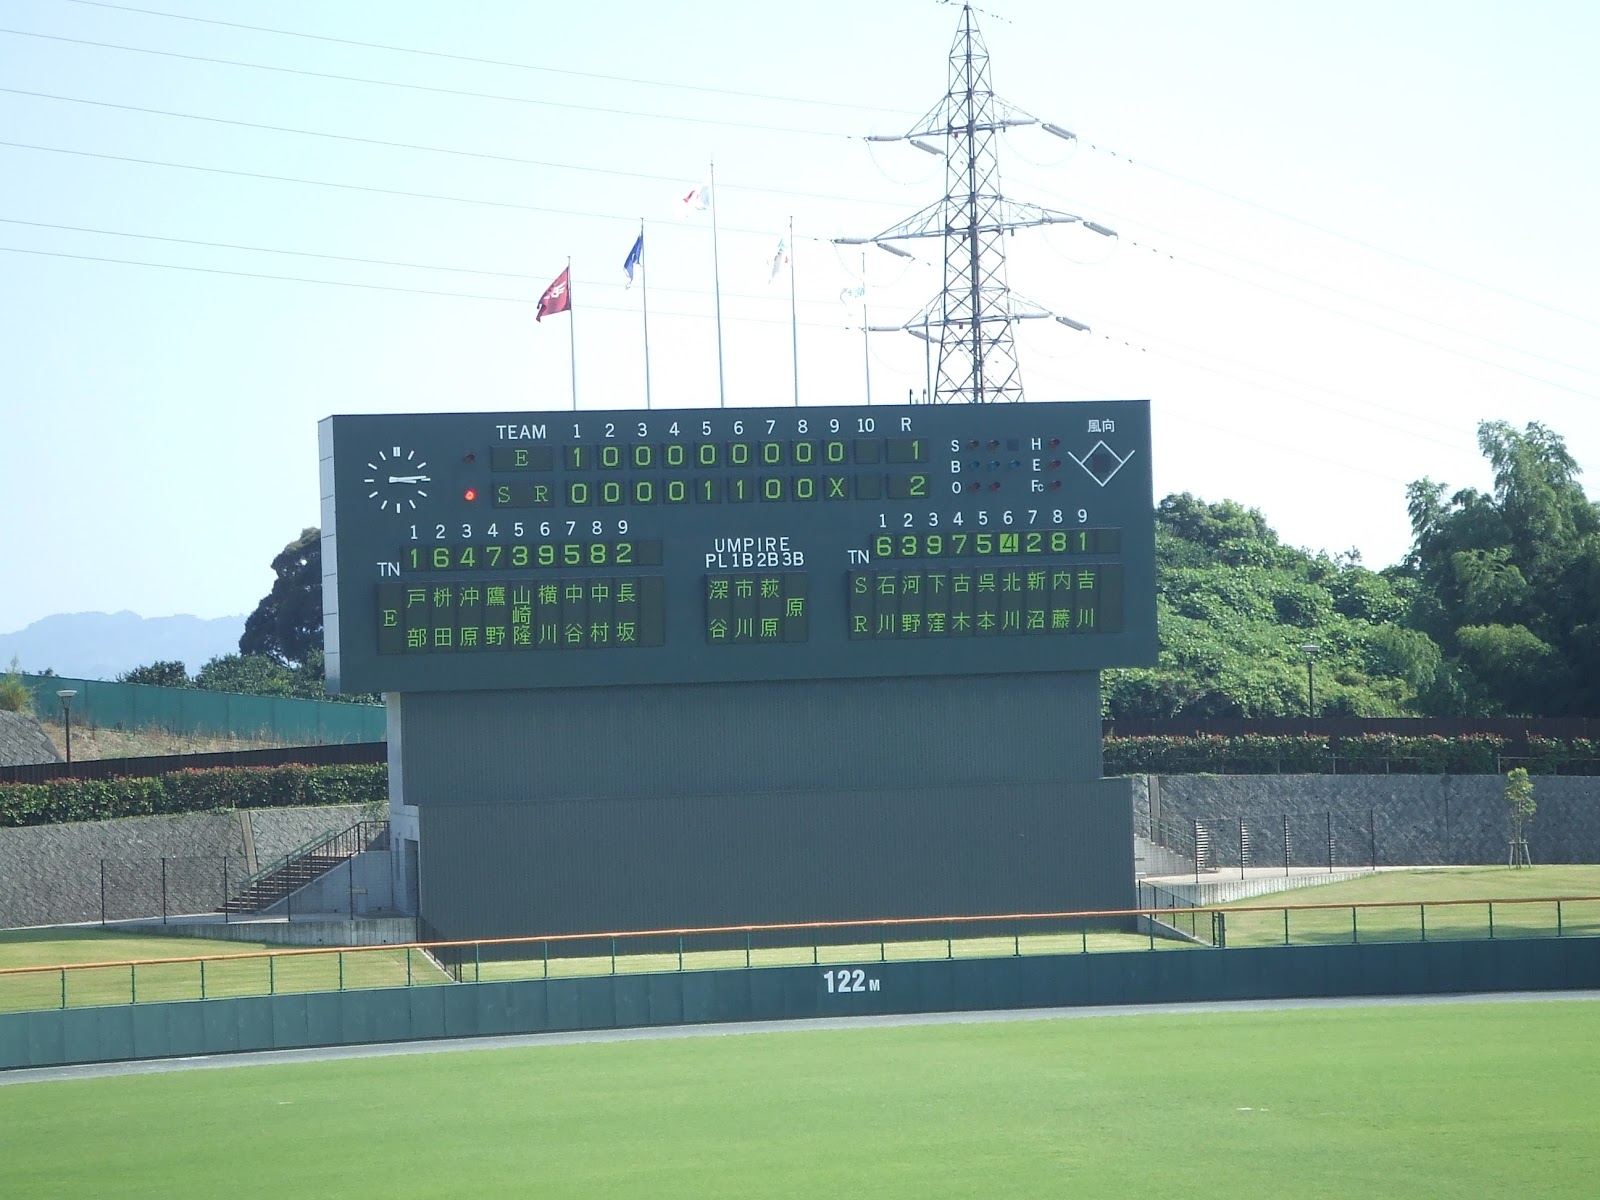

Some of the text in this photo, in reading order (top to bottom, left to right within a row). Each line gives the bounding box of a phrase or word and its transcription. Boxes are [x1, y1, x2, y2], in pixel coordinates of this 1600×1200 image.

[495, 417, 912, 440] TEAM 1 2 3 4 5 6 7 8 9 10 R
[1087, 418, 1115, 433] 風向
[514, 440, 920, 467] E 1 0 0 0 0 0 0 0 0 1
[951, 439, 960, 453] S
[1031, 437, 1042, 451] H
[950, 460, 961, 474] B
[1032, 458, 1041, 472] E
[498, 475, 925, 504] S R 0 0 0 0 1 1 0 0 X 2
[409, 519, 628, 540] 1 2 3 4 5 6 7 8 9
[878, 508, 1088, 528] 1 2 3 4 5 6 7 8 9
[376, 543, 632, 577] TN 1 6 4 7 3 9 5 8 2
[705, 551, 804, 569] PL 1B 2B 3B
[714, 536, 790, 553] UMPIRE
[847, 549, 870, 564] TN
[876, 536, 892, 556] 6
[901, 535, 917, 556] 3
[926, 535, 942, 555] 9
[951, 534, 967, 554] 7
[976, 533, 992, 554] 5
[1026, 532, 1042, 553] 2
[1051, 532, 1067, 552] 8
[1078, 531, 1087, 551] 1
[459, 586, 479, 647] 沖原
[485, 586, 506, 646] 鷹野
[564, 583, 584, 643] 中谷
[590, 583, 610, 643] 中村
[616, 583, 636, 642] 長坂
[709, 580, 729, 639] 深谷
[734, 578, 754, 638] 市川
[786, 597, 805, 617] 原
[854, 576, 868, 633] S R
[877, 575, 896, 634] 石川
[902, 575, 921, 633] 河野
[952, 573, 971, 632] 古木
[1002, 571, 1021, 630] 北川
[1027, 570, 1046, 630] 新沼
[383, 609, 398, 627] E
[407, 588, 427, 648] 戸部
